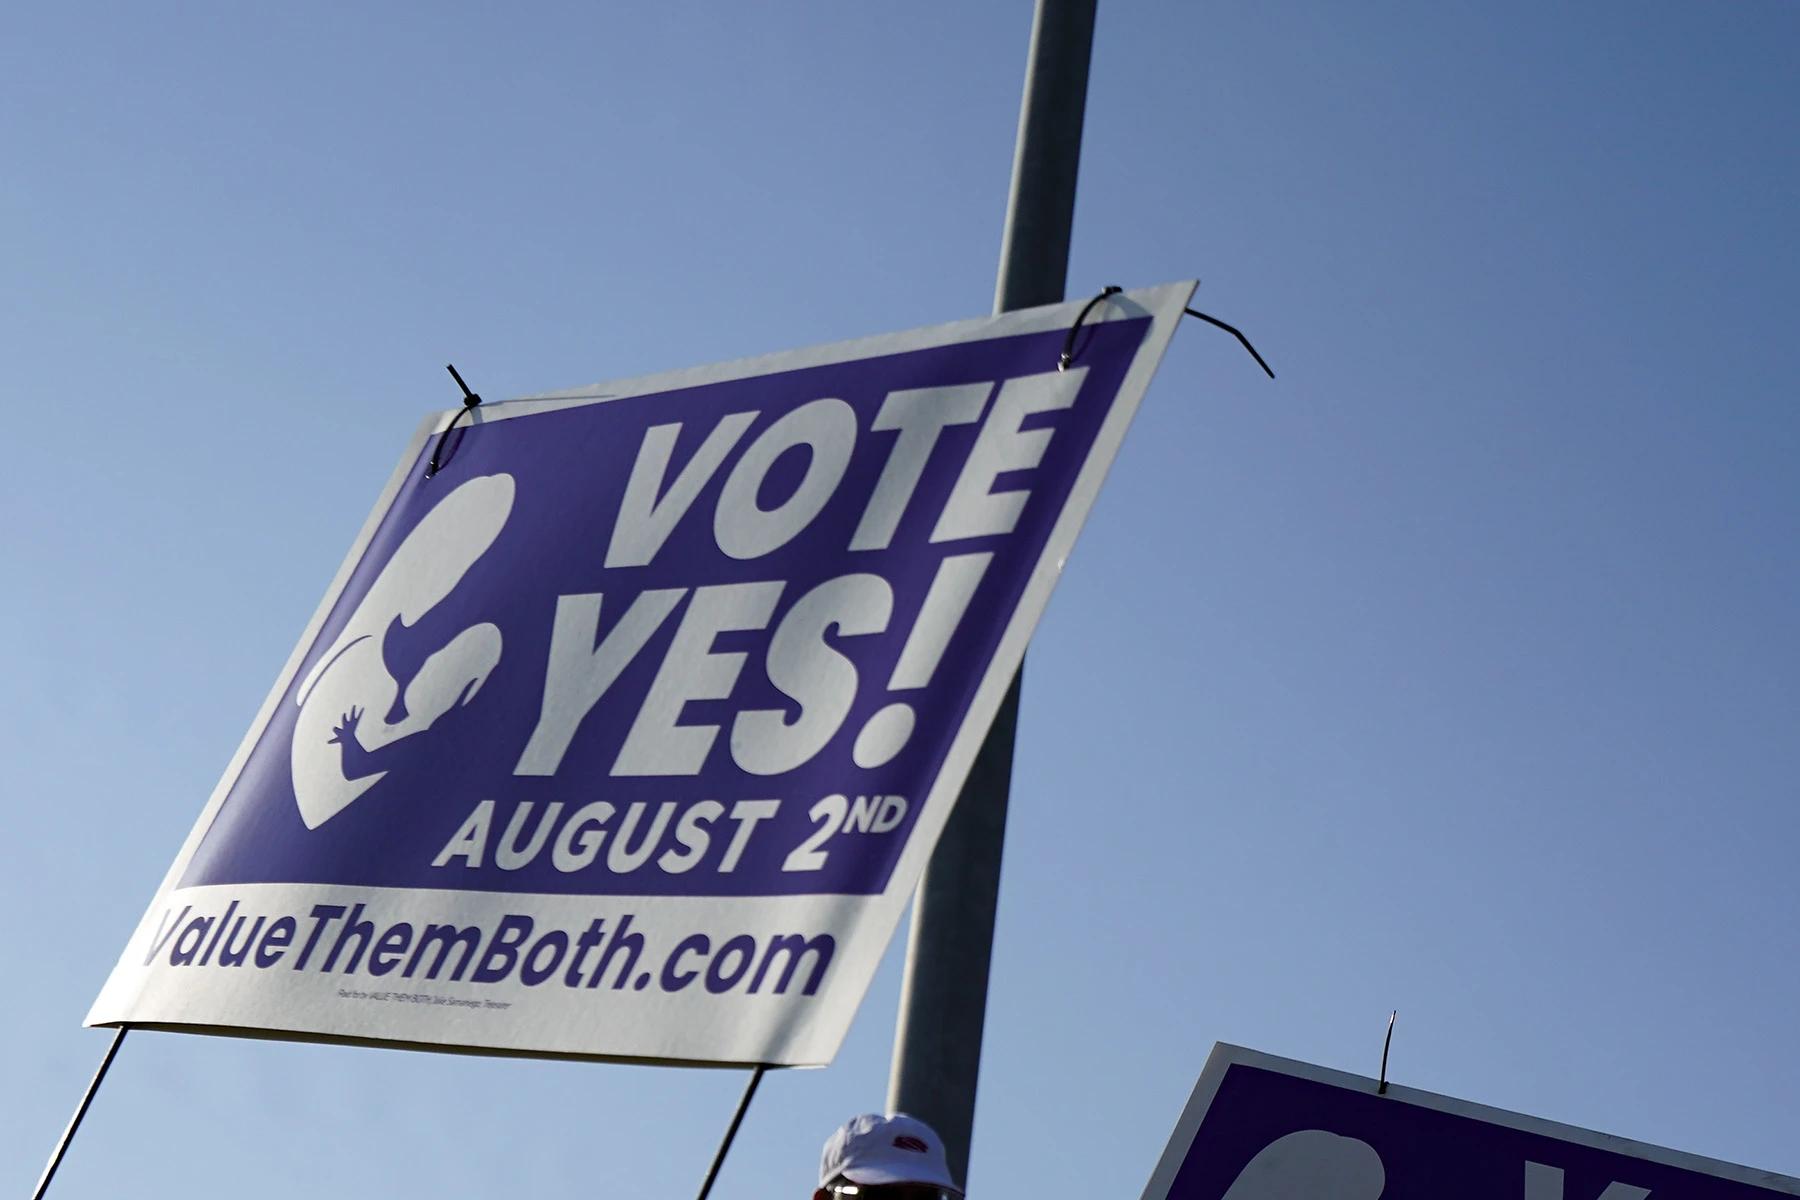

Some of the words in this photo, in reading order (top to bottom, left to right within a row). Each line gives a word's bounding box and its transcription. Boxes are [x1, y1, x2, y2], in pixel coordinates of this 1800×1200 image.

[603, 366, 1090, 568] VOTE
[512, 552, 995, 777] YES!
[431, 800, 782, 874] AUGUST
[781, 794, 908, 872] 2ND
[143, 900, 836, 995] ValueThemBoth.com
